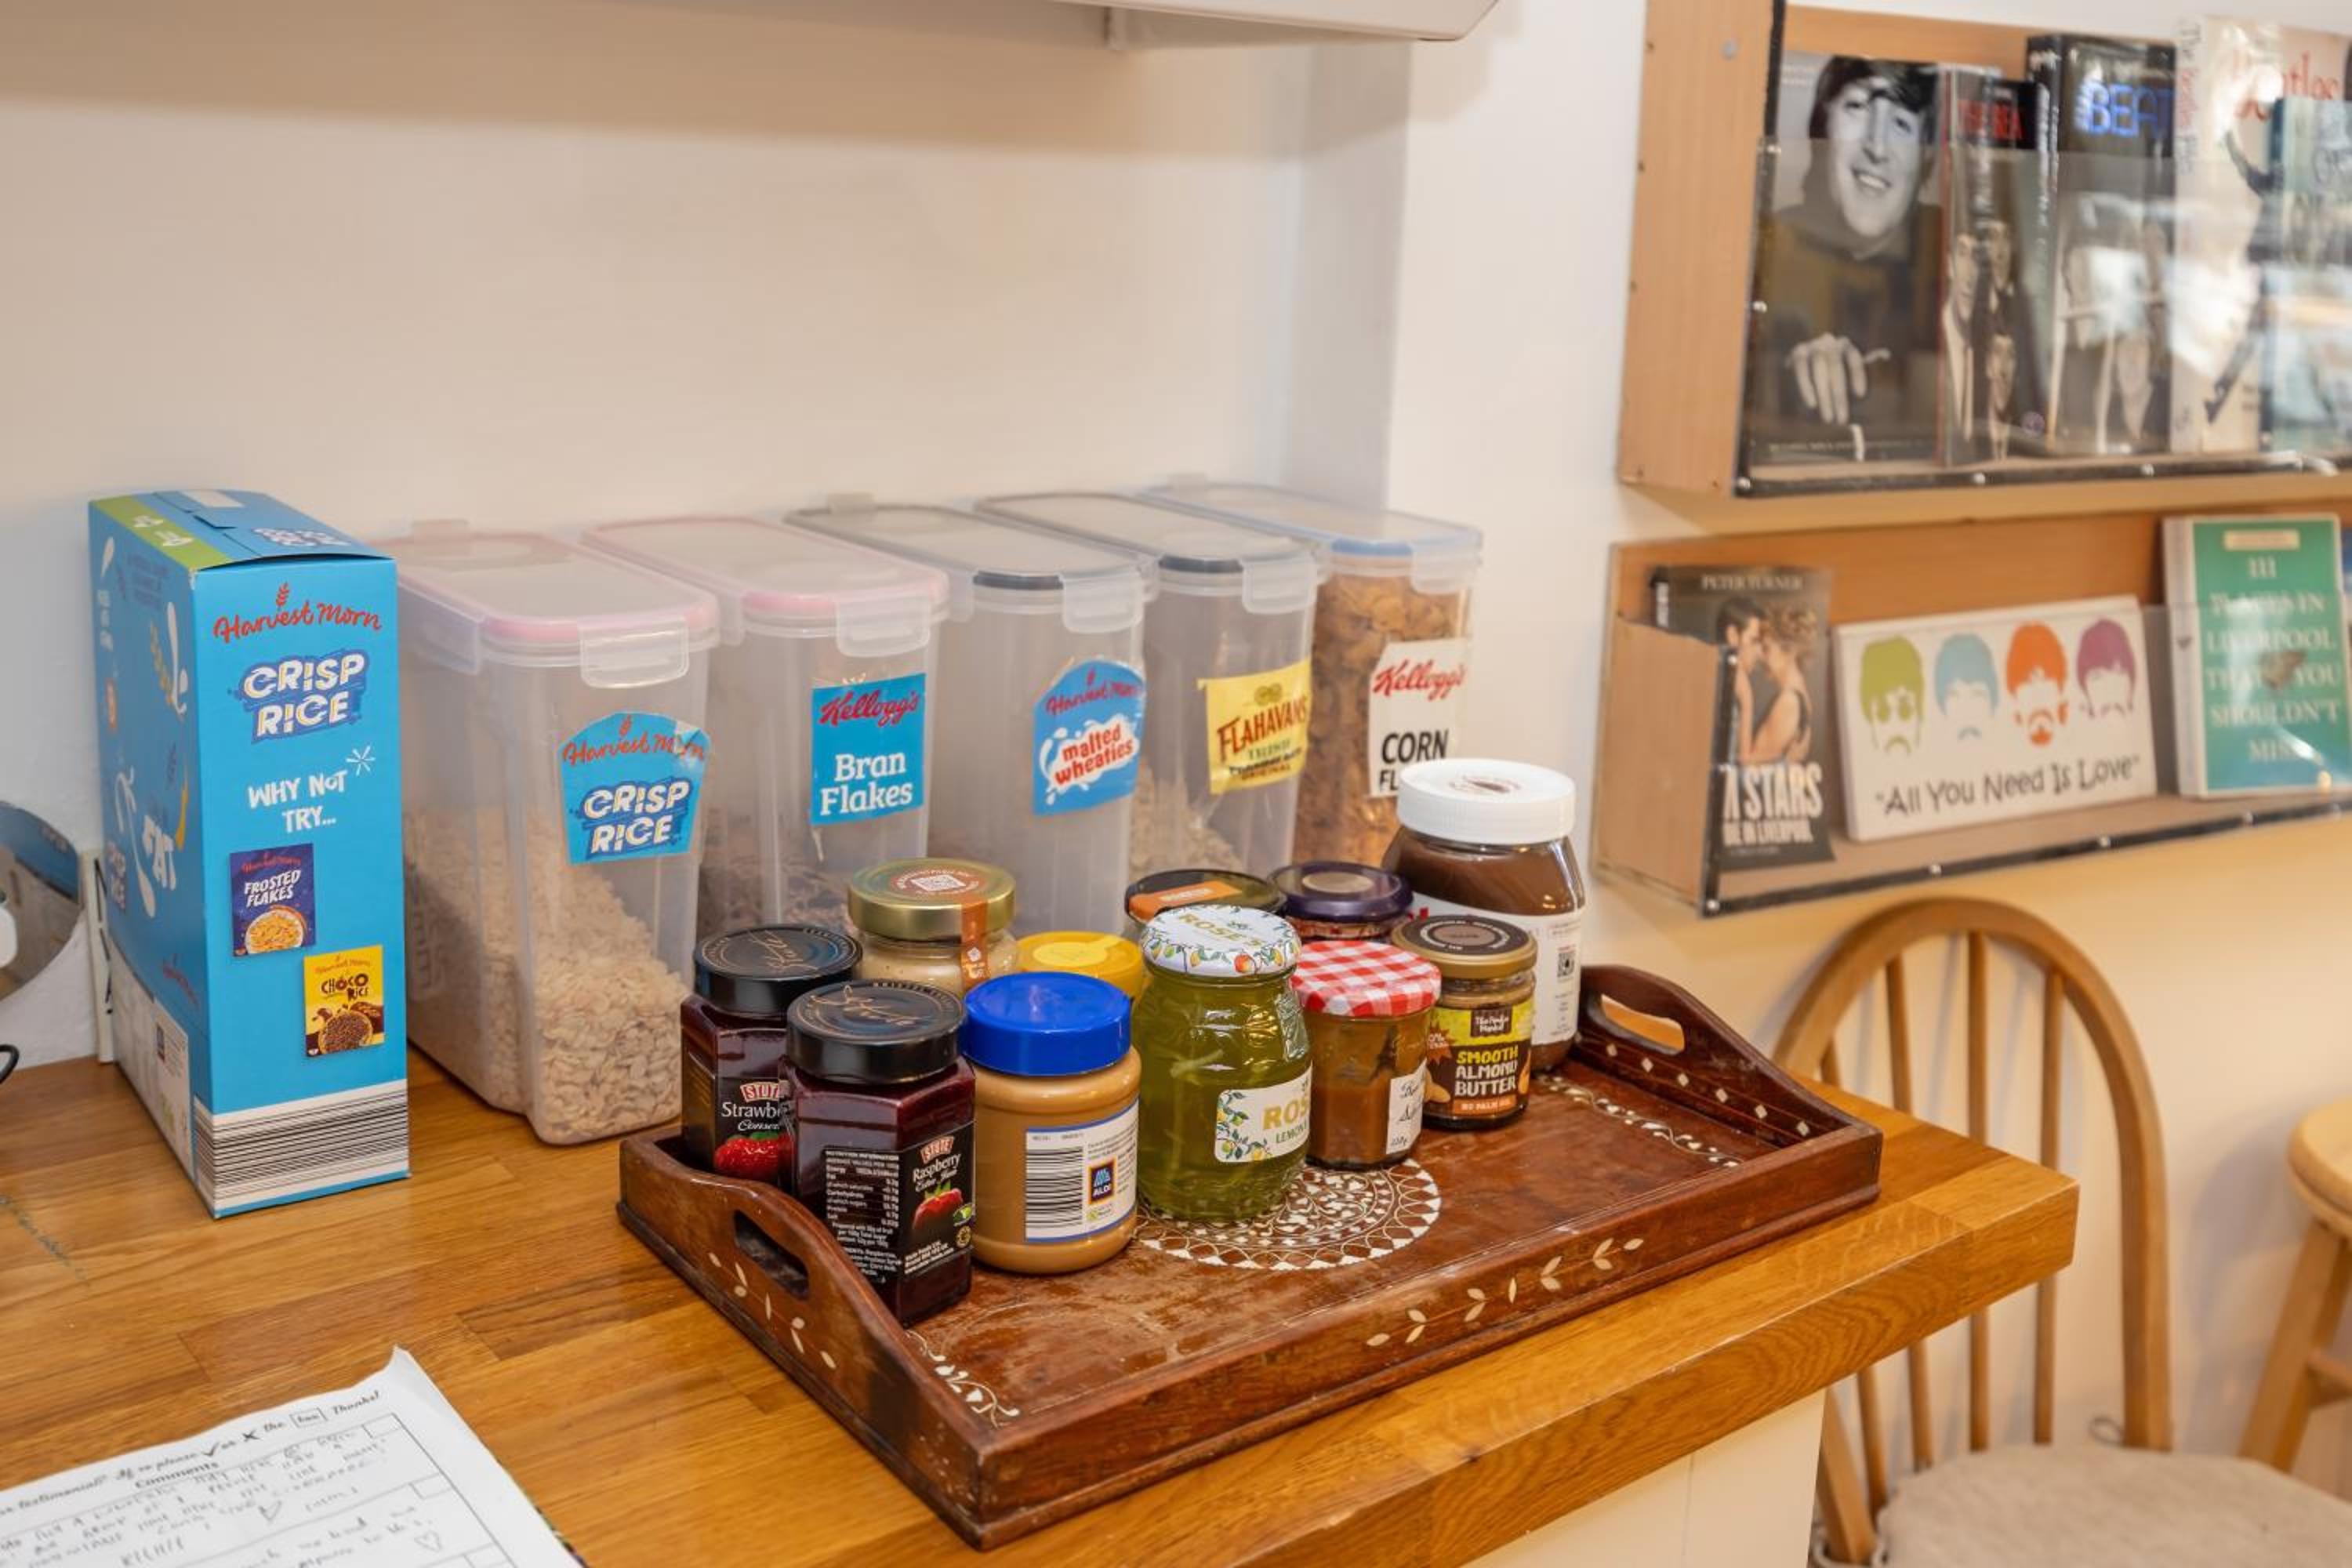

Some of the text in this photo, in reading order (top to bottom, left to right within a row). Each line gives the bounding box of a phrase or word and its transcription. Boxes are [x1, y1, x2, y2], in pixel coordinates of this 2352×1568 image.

[213, 602, 383, 643] Harvest Morn
[243, 653, 365, 699] CRISP
[1374, 659, 1467, 702] Kellogg's
[256, 691, 350, 737] RICE
[818, 689, 920, 728] Kellogg's
[1062, 724, 1121, 762] malted
[1382, 729, 1450, 764] CORN
[834, 752, 906, 782] Bran
[1054, 739, 1134, 785] wheaties
[248, 777, 301, 809] WHY
[584, 782, 691, 818] CRISP
[820, 781, 913, 816] Flakes
[1744, 760, 1824, 820] STARS
[1928, 780, 1976, 812] You
[1984, 768, 2045, 804] Need
[2053, 763, 2071, 796] Is
[282, 806, 337, 833] TRY...
[591, 815, 673, 854] RICE
[244, 869, 302, 895] FROSTED
[245, 884, 294, 908] FLAKES
[321, 973, 369, 994] CHOCO
[1455, 1060, 1519, 1080] ALMOND
[1456, 1044, 1519, 1065] SMOOTH
[1454, 1076, 1516, 1097] BUTTER
[721, 1101, 780, 1119] Strawb
[913, 1154, 962, 1182] Raspberry
[263, 1421, 287, 1433] the
[134, 1461, 220, 1490] Comments
